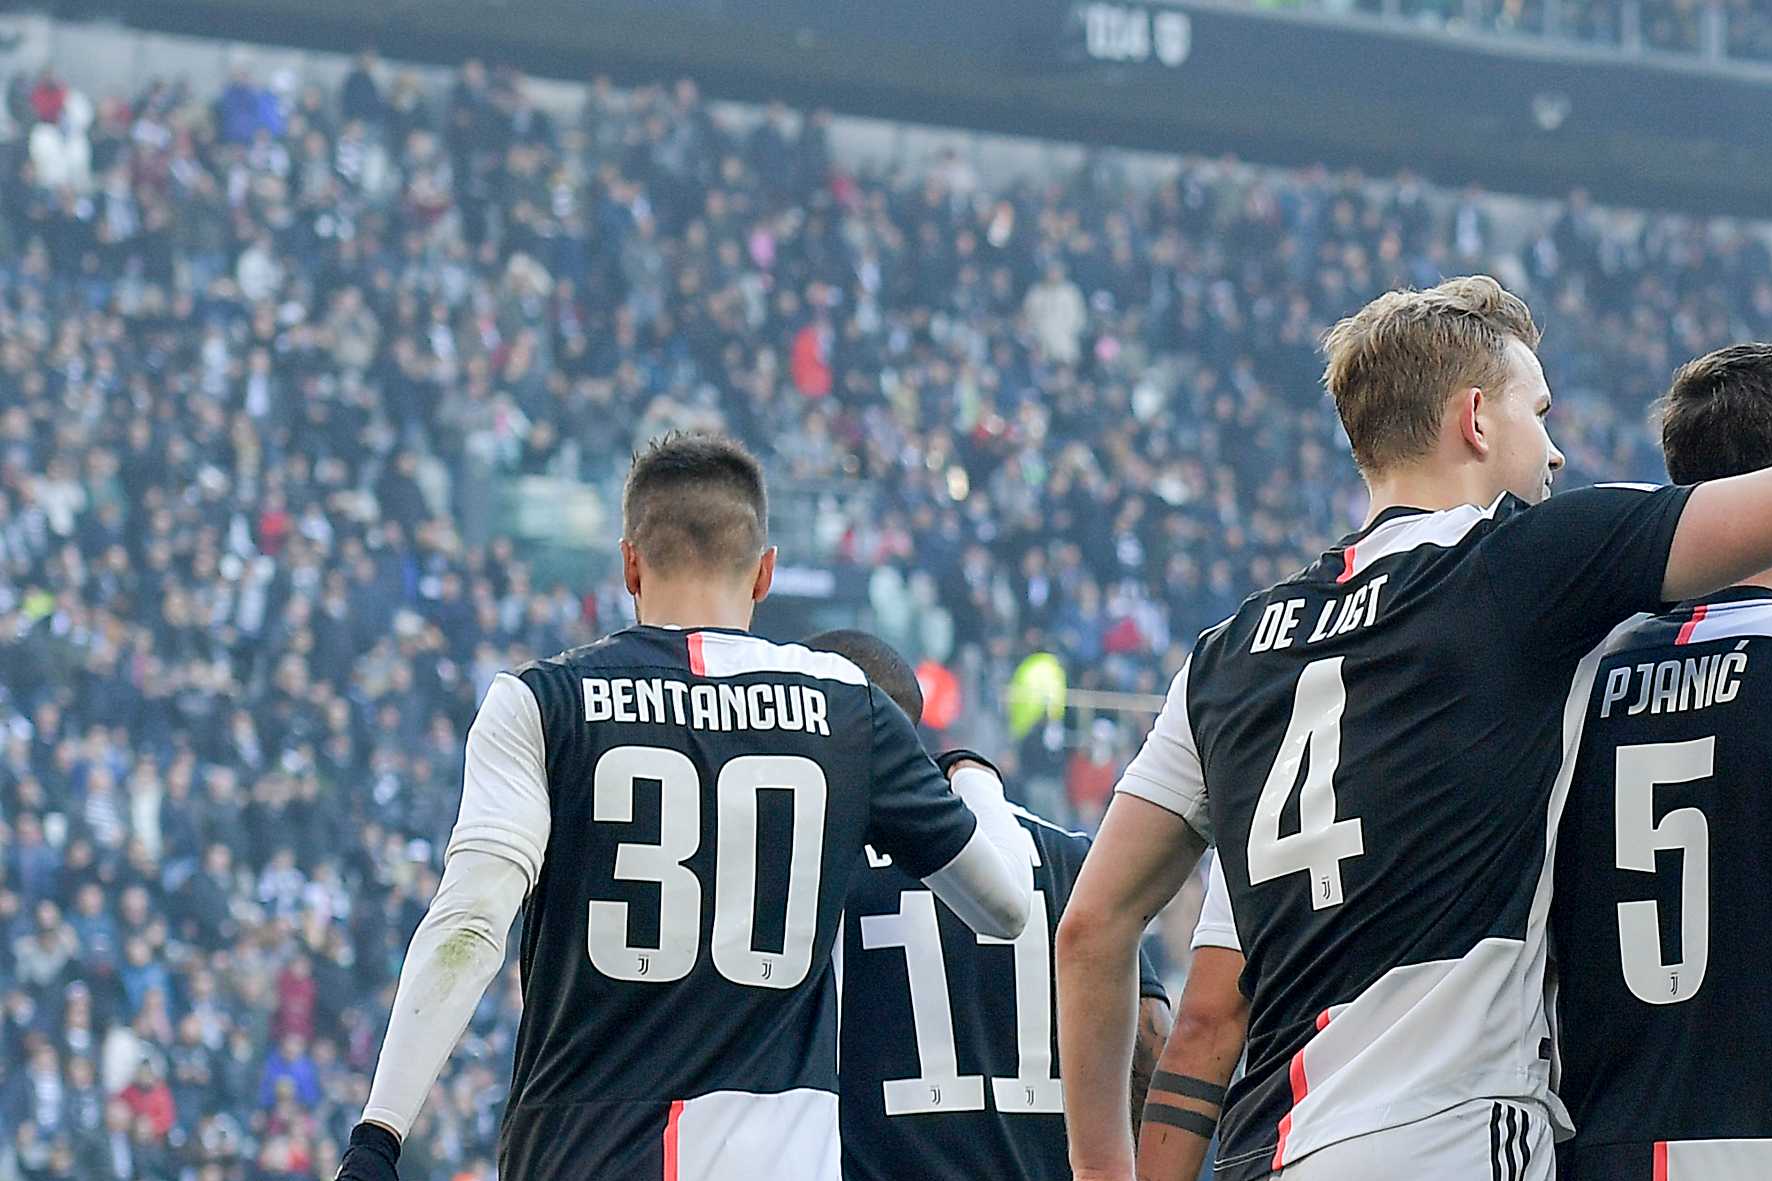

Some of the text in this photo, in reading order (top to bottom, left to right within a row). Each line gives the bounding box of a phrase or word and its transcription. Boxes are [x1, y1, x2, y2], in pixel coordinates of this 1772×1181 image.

[582, 678, 830, 736] BENTANCUR
[1250, 574, 1389, 654] DE LIGT
[1601, 640, 1748, 718] PJANIĆ
[588, 746, 828, 989] 30
[1247, 656, 1364, 911] 4
[1615, 736, 1716, 1004] 5
[859, 890, 1064, 1116] 11
